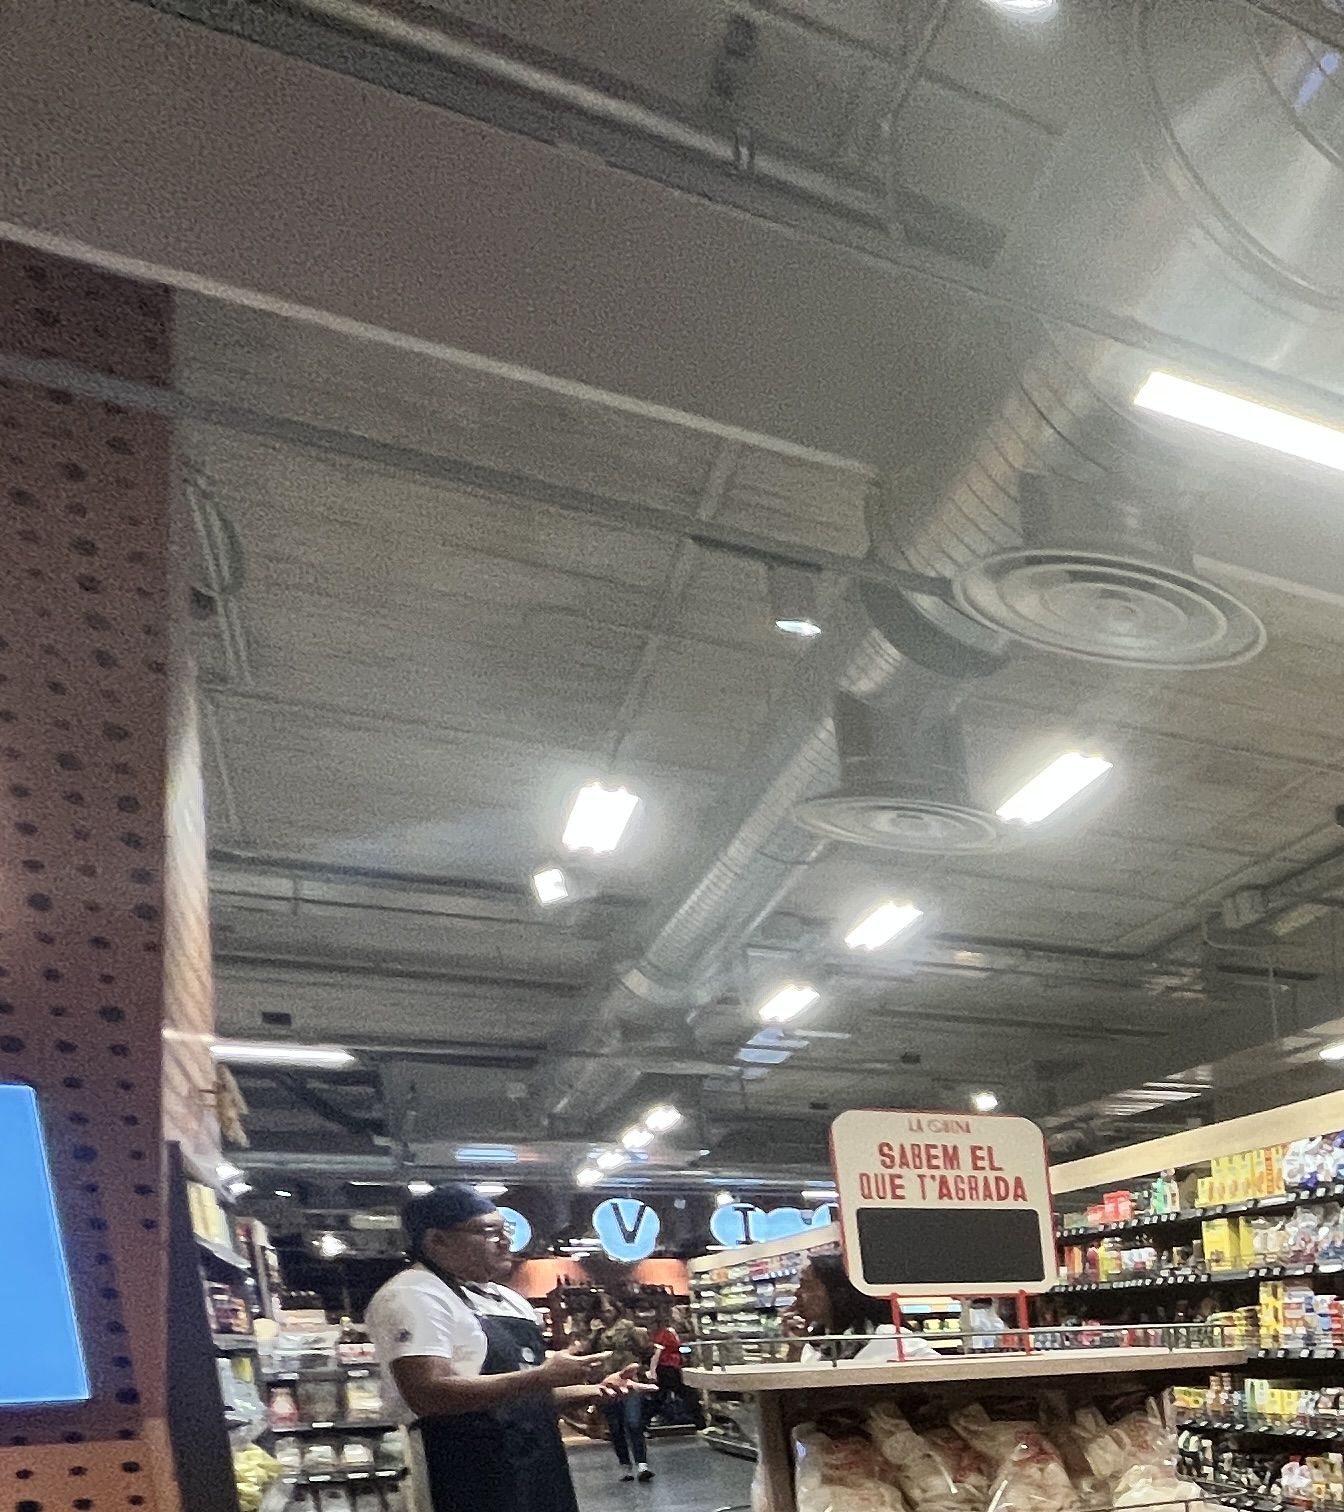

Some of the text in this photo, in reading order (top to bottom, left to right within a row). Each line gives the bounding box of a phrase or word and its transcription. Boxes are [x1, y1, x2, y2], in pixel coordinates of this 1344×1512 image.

[878, 1141, 1003, 1172] SABEM EL
[859, 1173, 1028, 1202] QUE T'AGRADA
